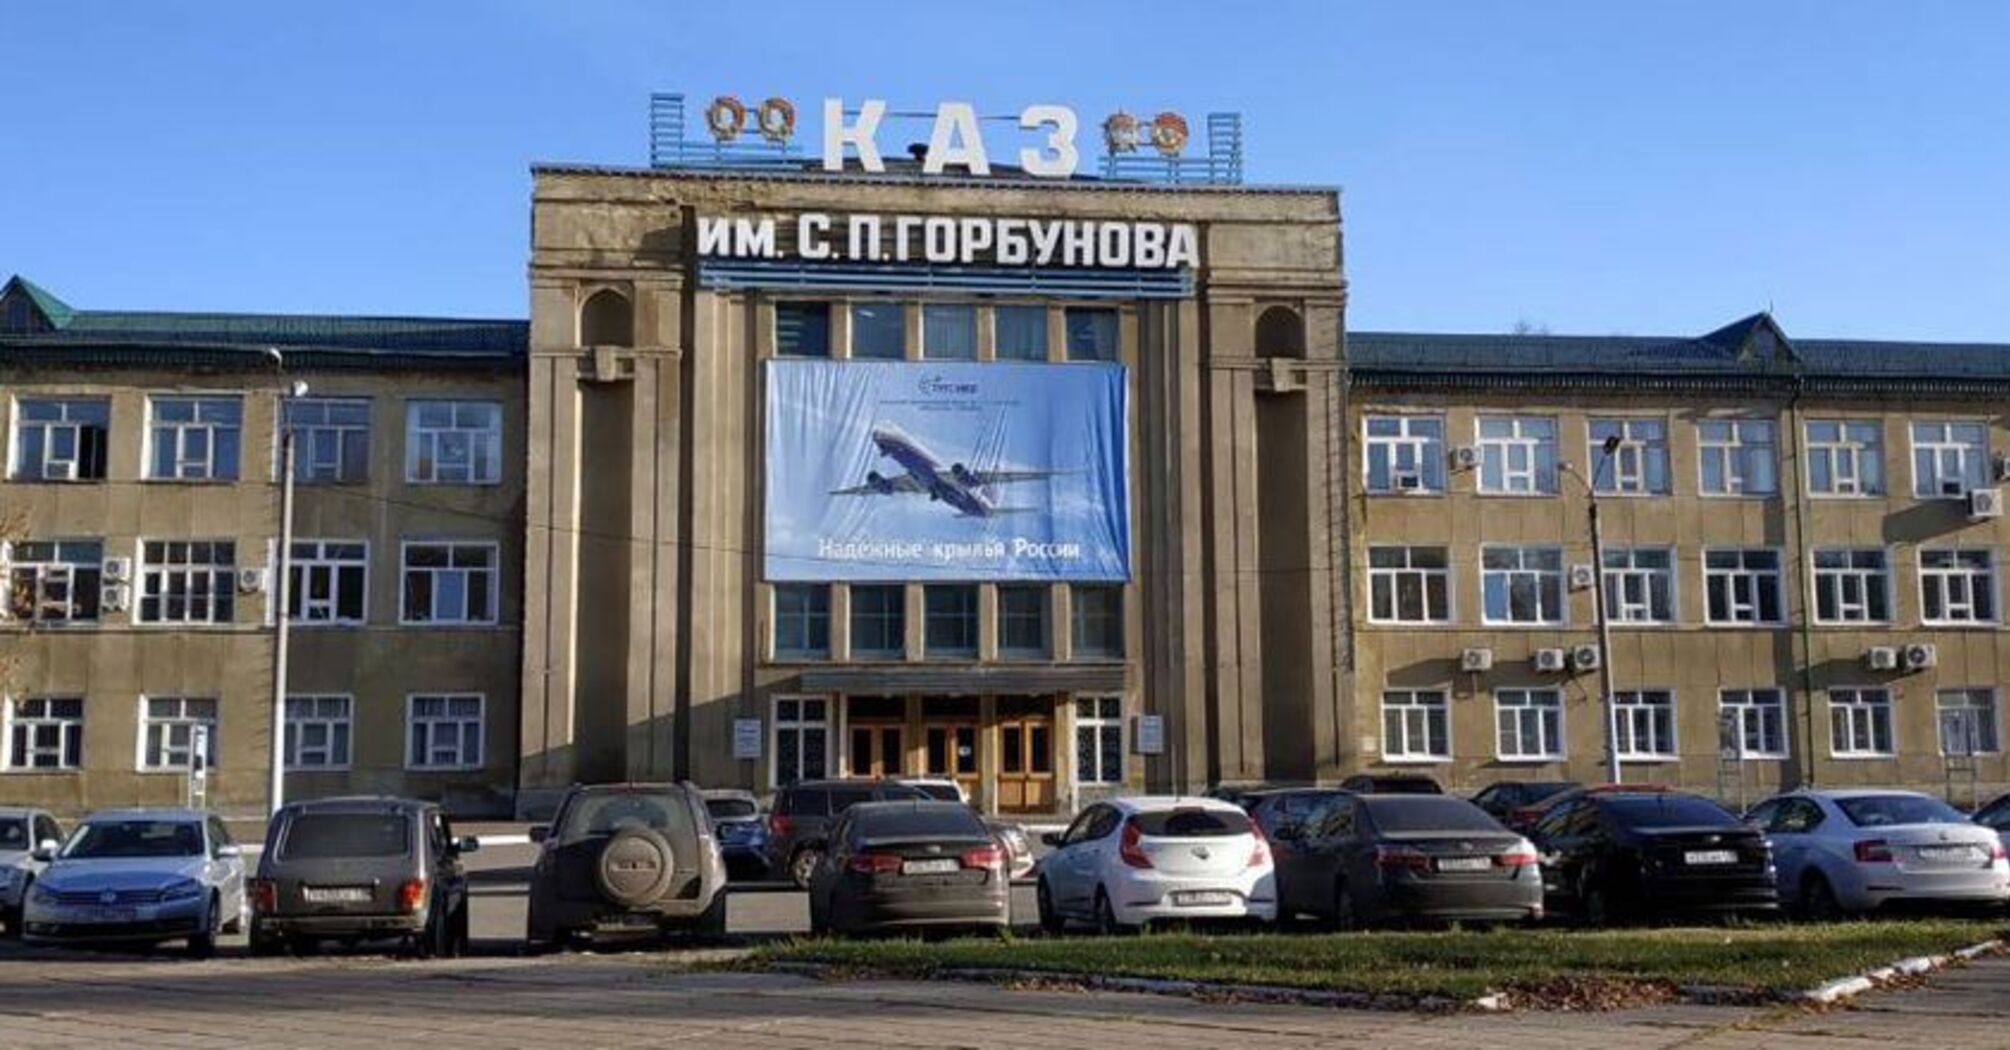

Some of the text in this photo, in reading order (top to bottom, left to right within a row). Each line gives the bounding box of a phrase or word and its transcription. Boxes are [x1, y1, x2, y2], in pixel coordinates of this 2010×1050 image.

[823, 97, 1079, 177] КАЗ
[697, 217, 784, 258] ИМ.
[934, 541, 1005, 561] крылья
[1013, 536, 1080, 560] России
